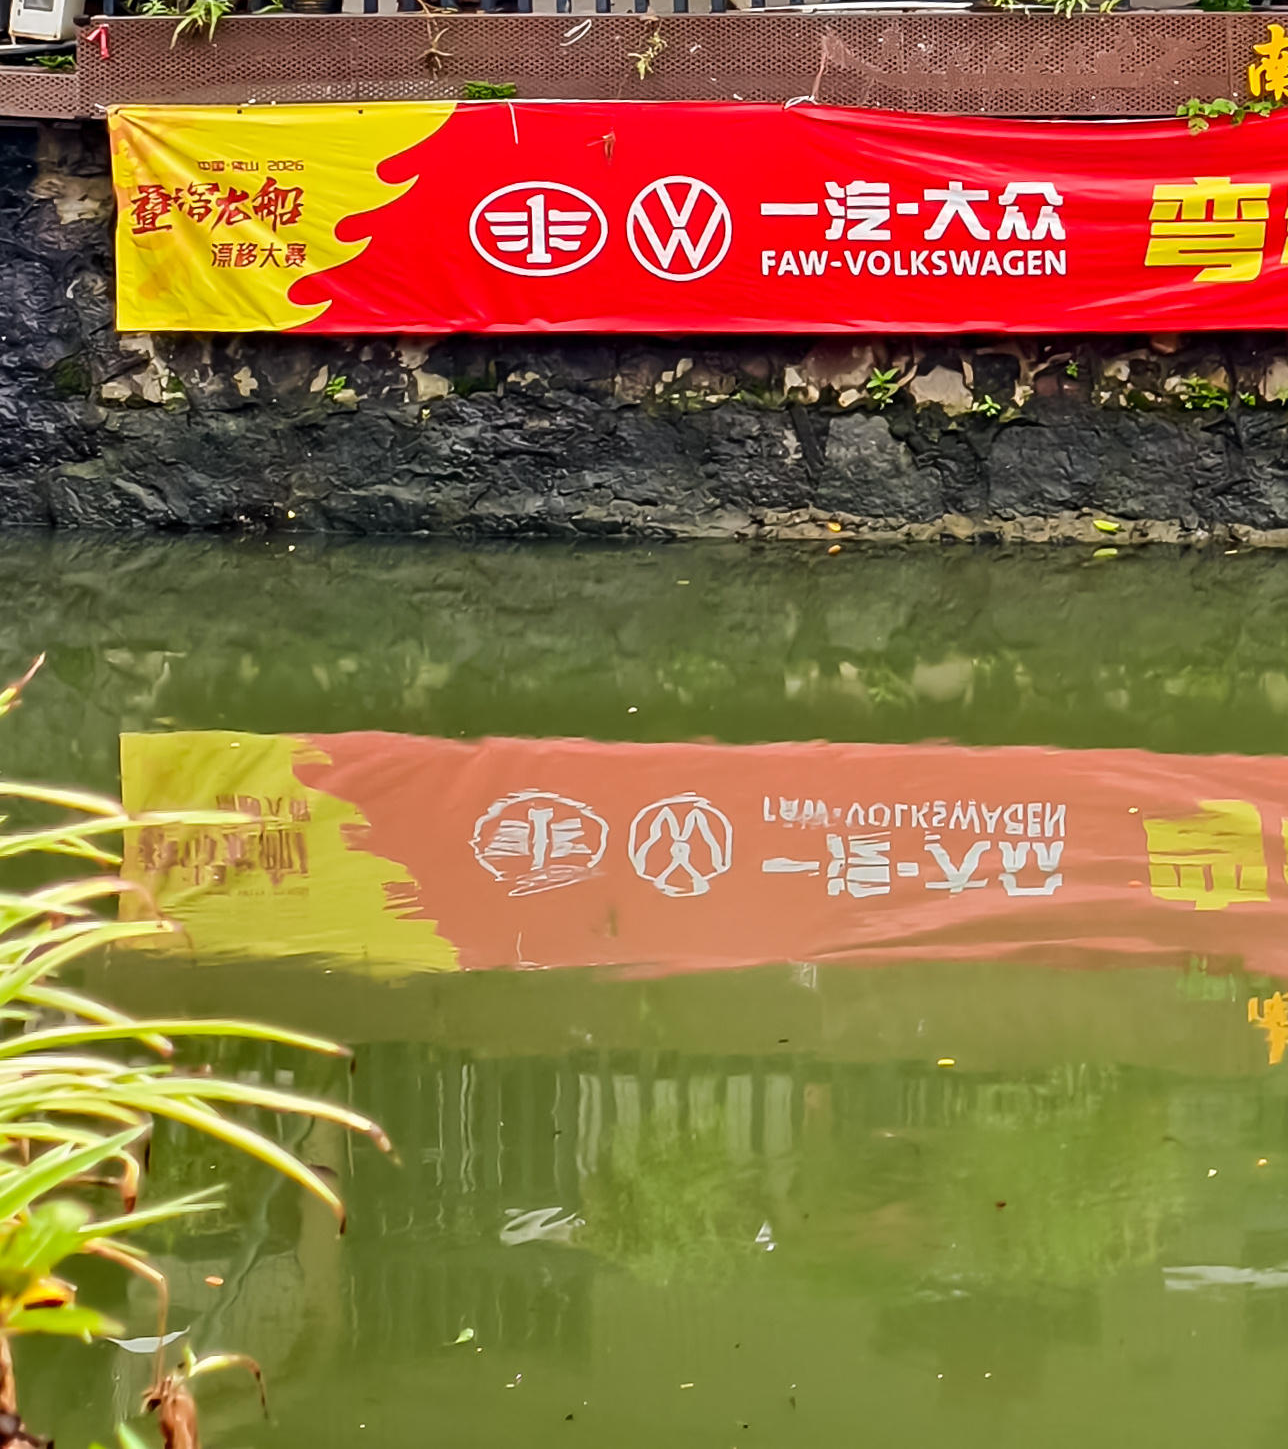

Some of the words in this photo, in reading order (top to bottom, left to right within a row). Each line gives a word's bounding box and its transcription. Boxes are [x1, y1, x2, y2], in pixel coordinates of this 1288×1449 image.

[267, 160, 304, 171] 2026
[760, 180, 1067, 242] 一汽-大众
[211, 242, 307, 268] 漂移大赛
[761, 249, 1067, 276] FAW-VOLKSWAGEN
